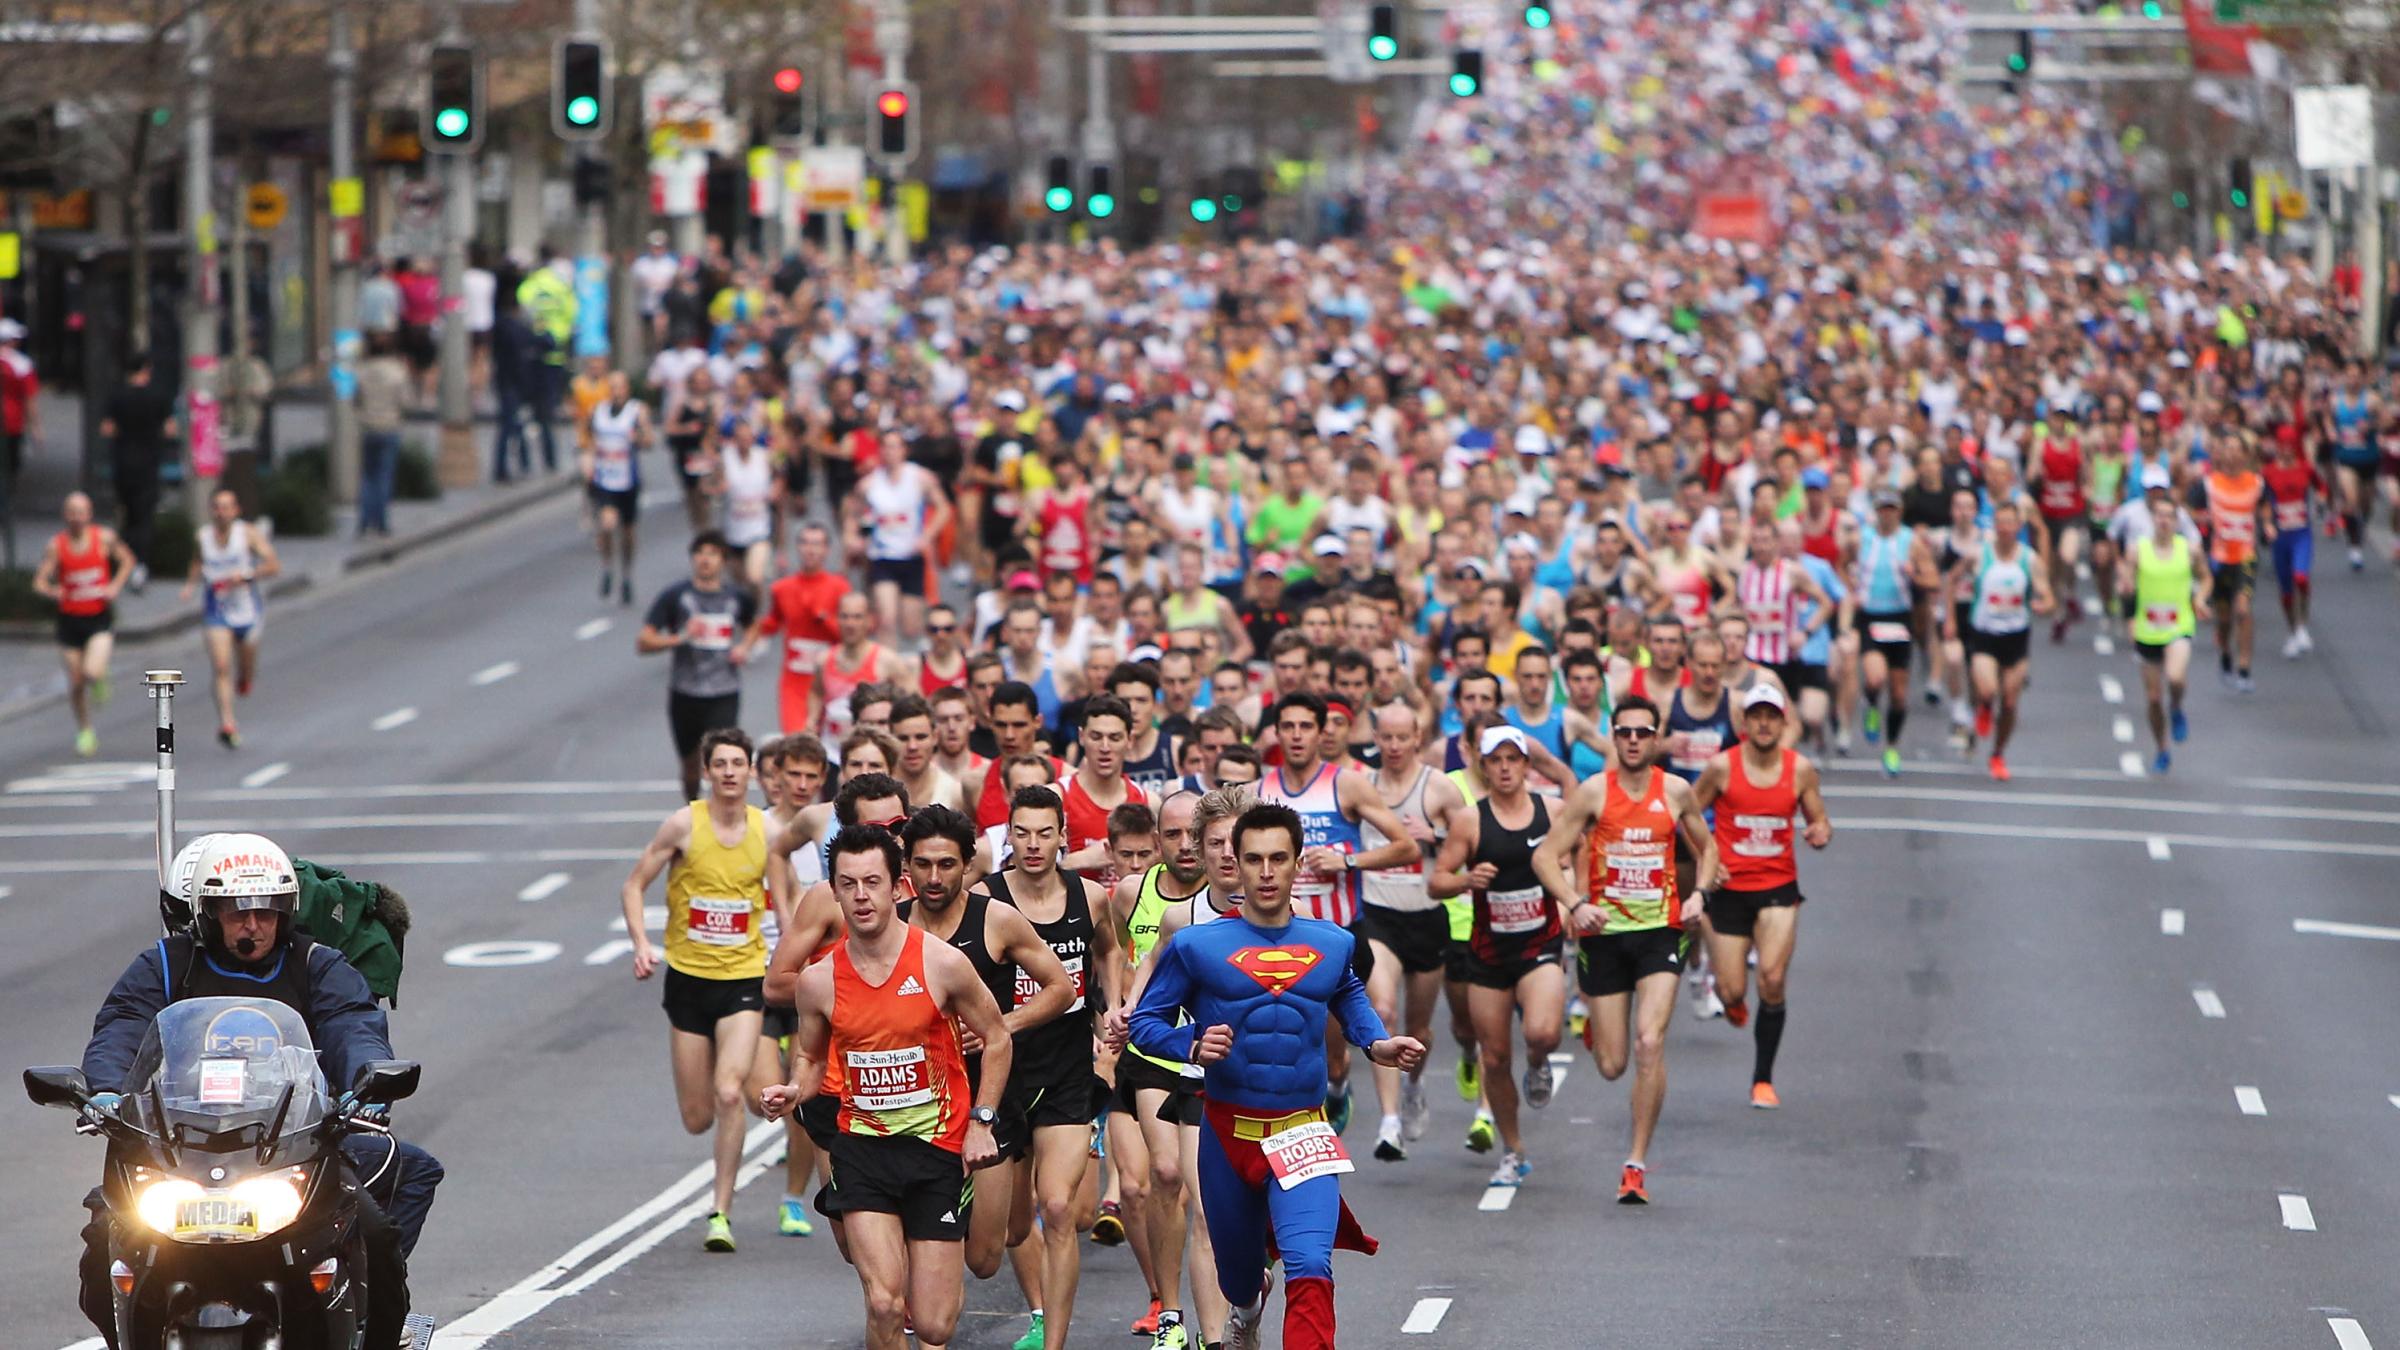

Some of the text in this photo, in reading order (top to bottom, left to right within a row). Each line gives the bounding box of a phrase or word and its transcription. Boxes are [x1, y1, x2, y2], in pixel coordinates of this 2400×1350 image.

[213, 854, 284, 876] YAMAHA
[1619, 869, 1649, 883] PAGE
[706, 911, 733, 926] COX
[853, 1054, 867, 1064] The
[860, 1065, 917, 1086] ADAMS
[870, 1097, 912, 1105] Westpac
[1279, 1137, 1335, 1165] HOBBS
[176, 1200, 255, 1227] MEDIA
